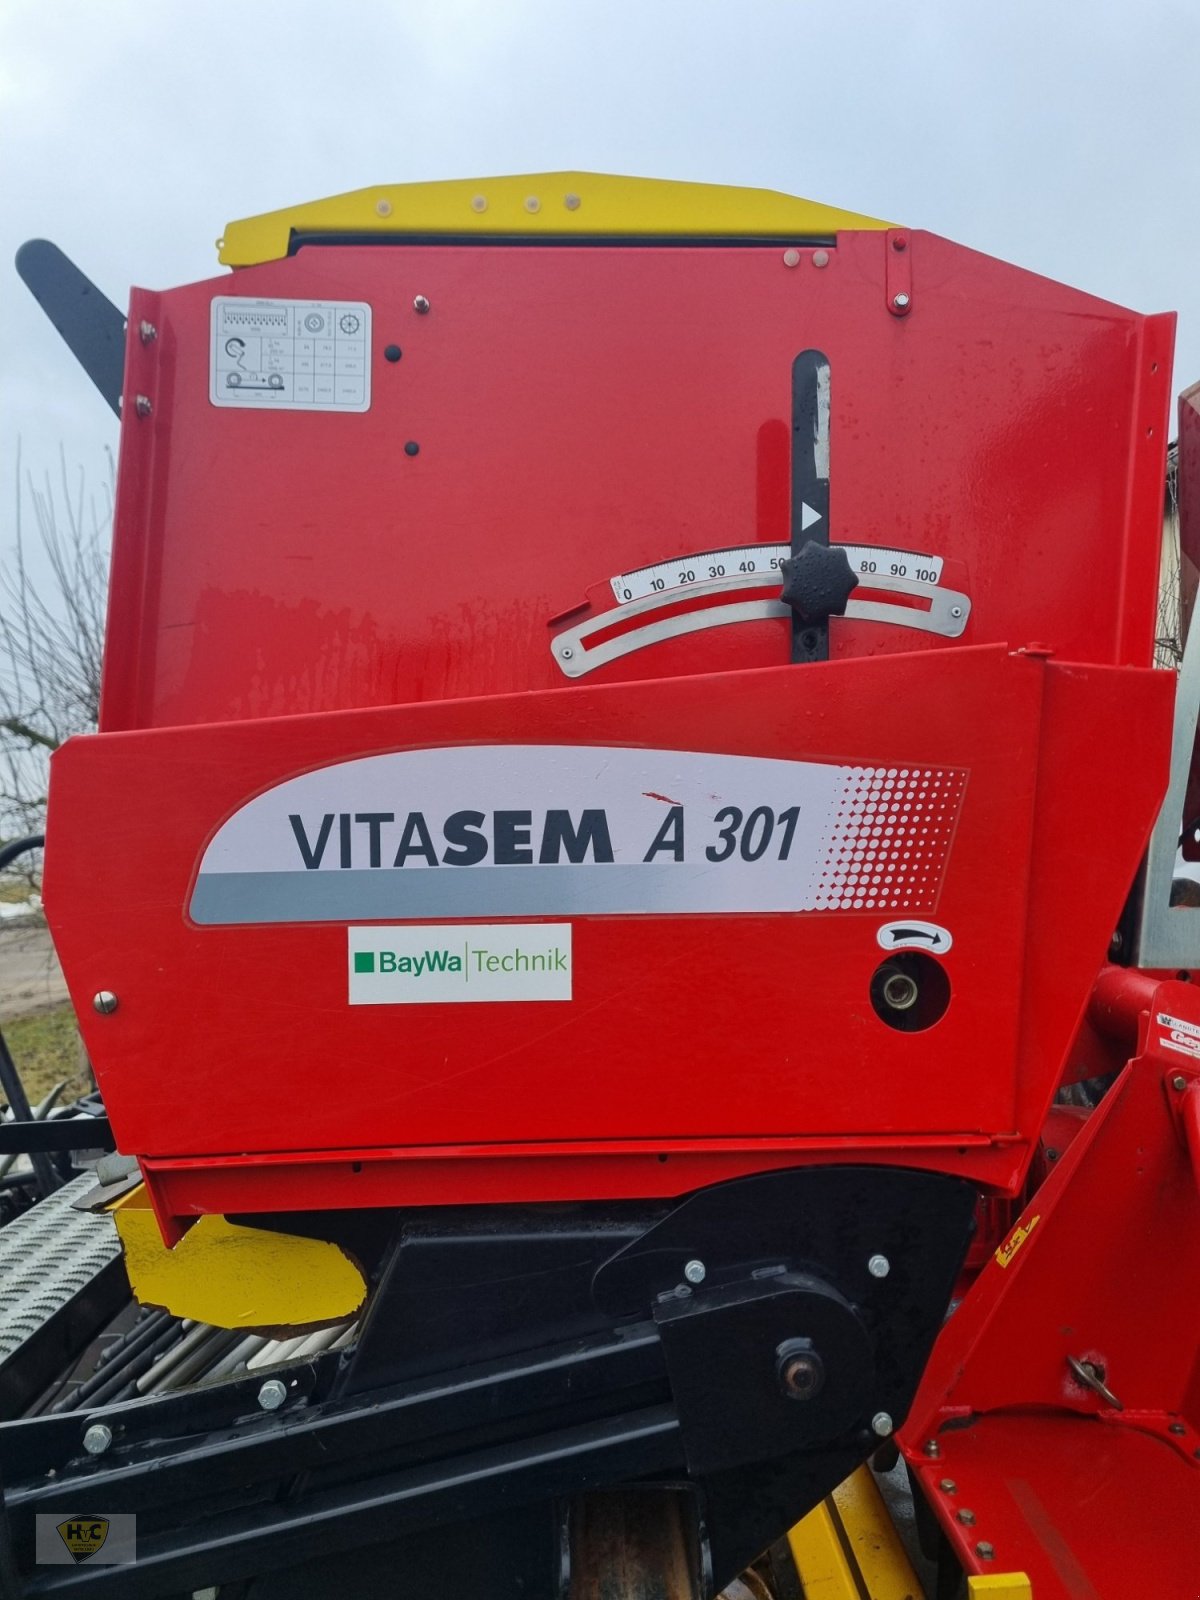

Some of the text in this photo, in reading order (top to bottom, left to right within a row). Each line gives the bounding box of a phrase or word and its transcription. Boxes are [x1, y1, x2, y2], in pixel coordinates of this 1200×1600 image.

[623, 588, 633, 601] 0
[650, 578, 665, 593] 10
[678, 570, 696, 584] 20
[708, 564, 726, 578] 30
[738, 560, 756, 573] 40
[860, 560, 877, 573] 80
[890, 563, 907, 577] 90
[914, 568, 937, 583] 100
[287, 805, 801, 870] VITASEM A 301
[379, 947, 568, 977] BayWa Technik
